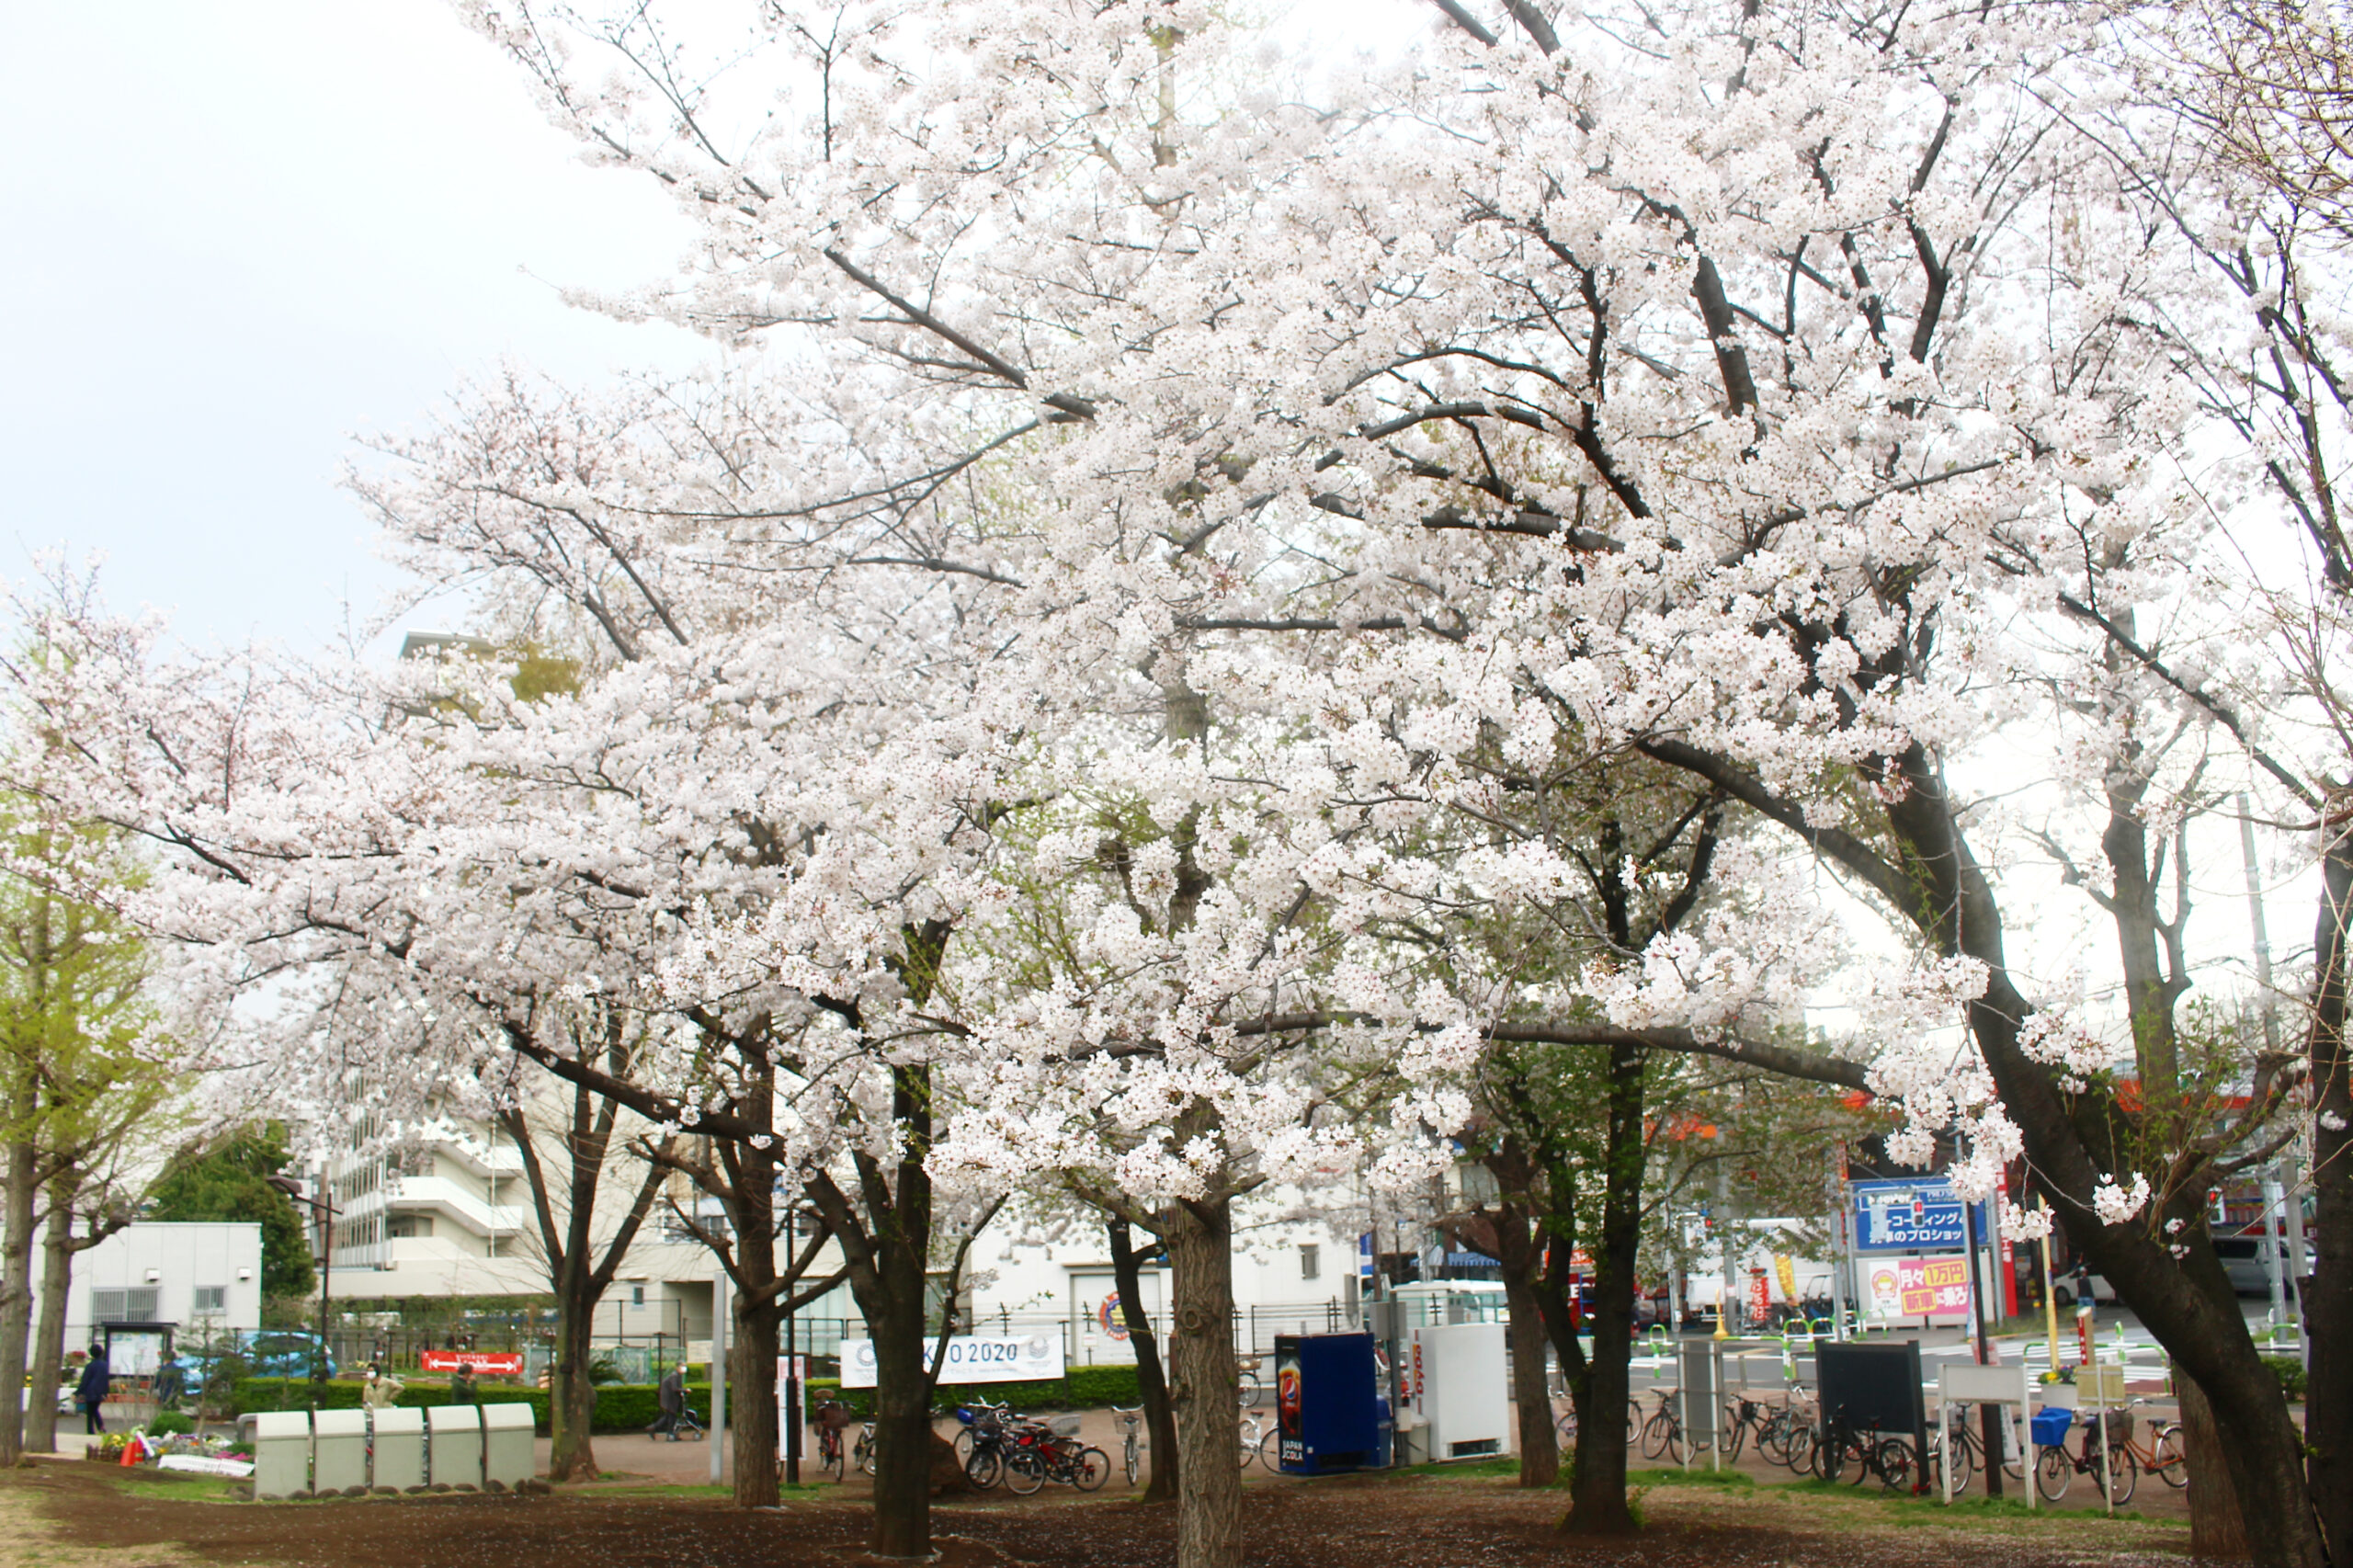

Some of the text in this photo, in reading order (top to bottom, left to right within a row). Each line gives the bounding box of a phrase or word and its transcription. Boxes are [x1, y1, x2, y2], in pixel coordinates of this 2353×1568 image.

[1904, 1286, 1968, 1311] 新車に乗ろ
[969, 1343, 1017, 1362] 2020
